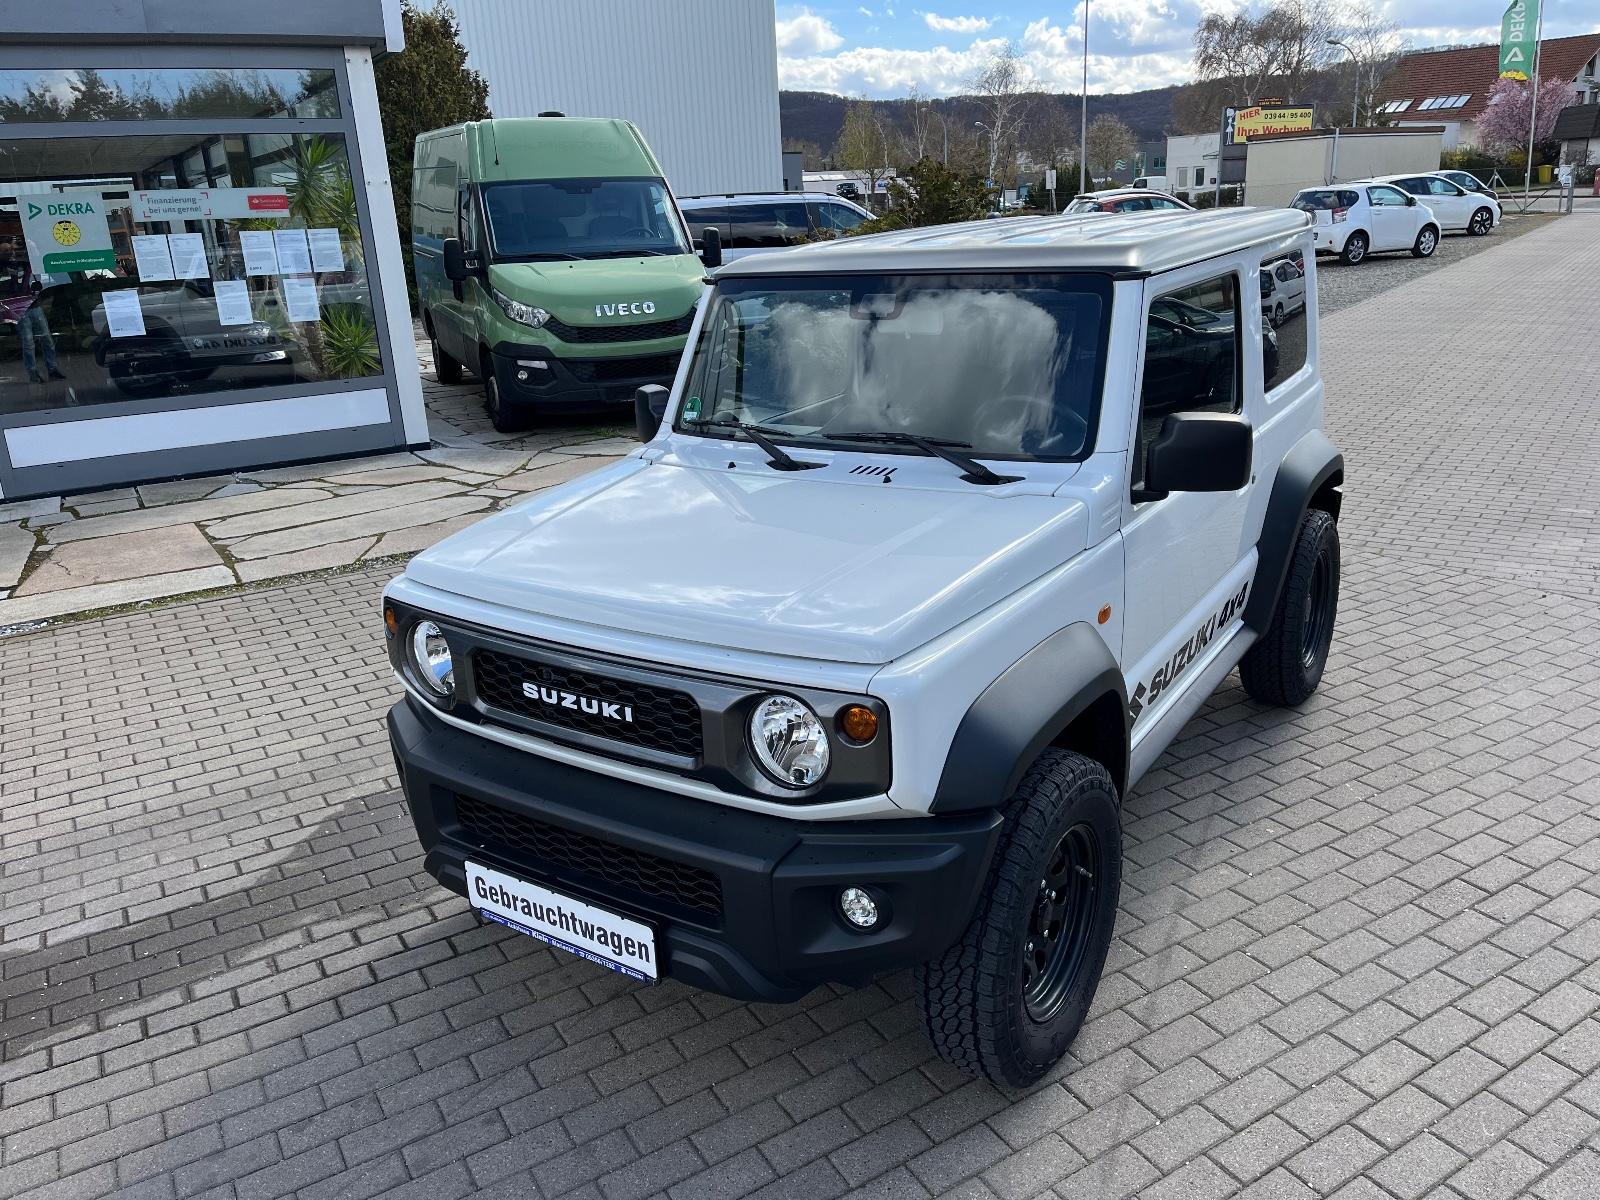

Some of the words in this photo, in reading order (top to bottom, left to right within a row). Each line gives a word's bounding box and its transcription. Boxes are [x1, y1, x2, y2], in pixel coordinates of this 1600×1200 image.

[1239, 109, 1260, 120] HIER
[1237, 127, 1259, 136] Ihre
[147, 196, 197, 205] Finanzierung
[48, 202, 95, 216] DEKRA
[177, 206, 202, 215] gerne!
[594, 301, 656, 317] IVECO
[1147, 612, 1218, 705] SUZUKI
[522, 682, 633, 722] SUZUKI
[474, 876, 650, 963] Gebrauchtwagen
[531, 930, 549, 943] Klein
